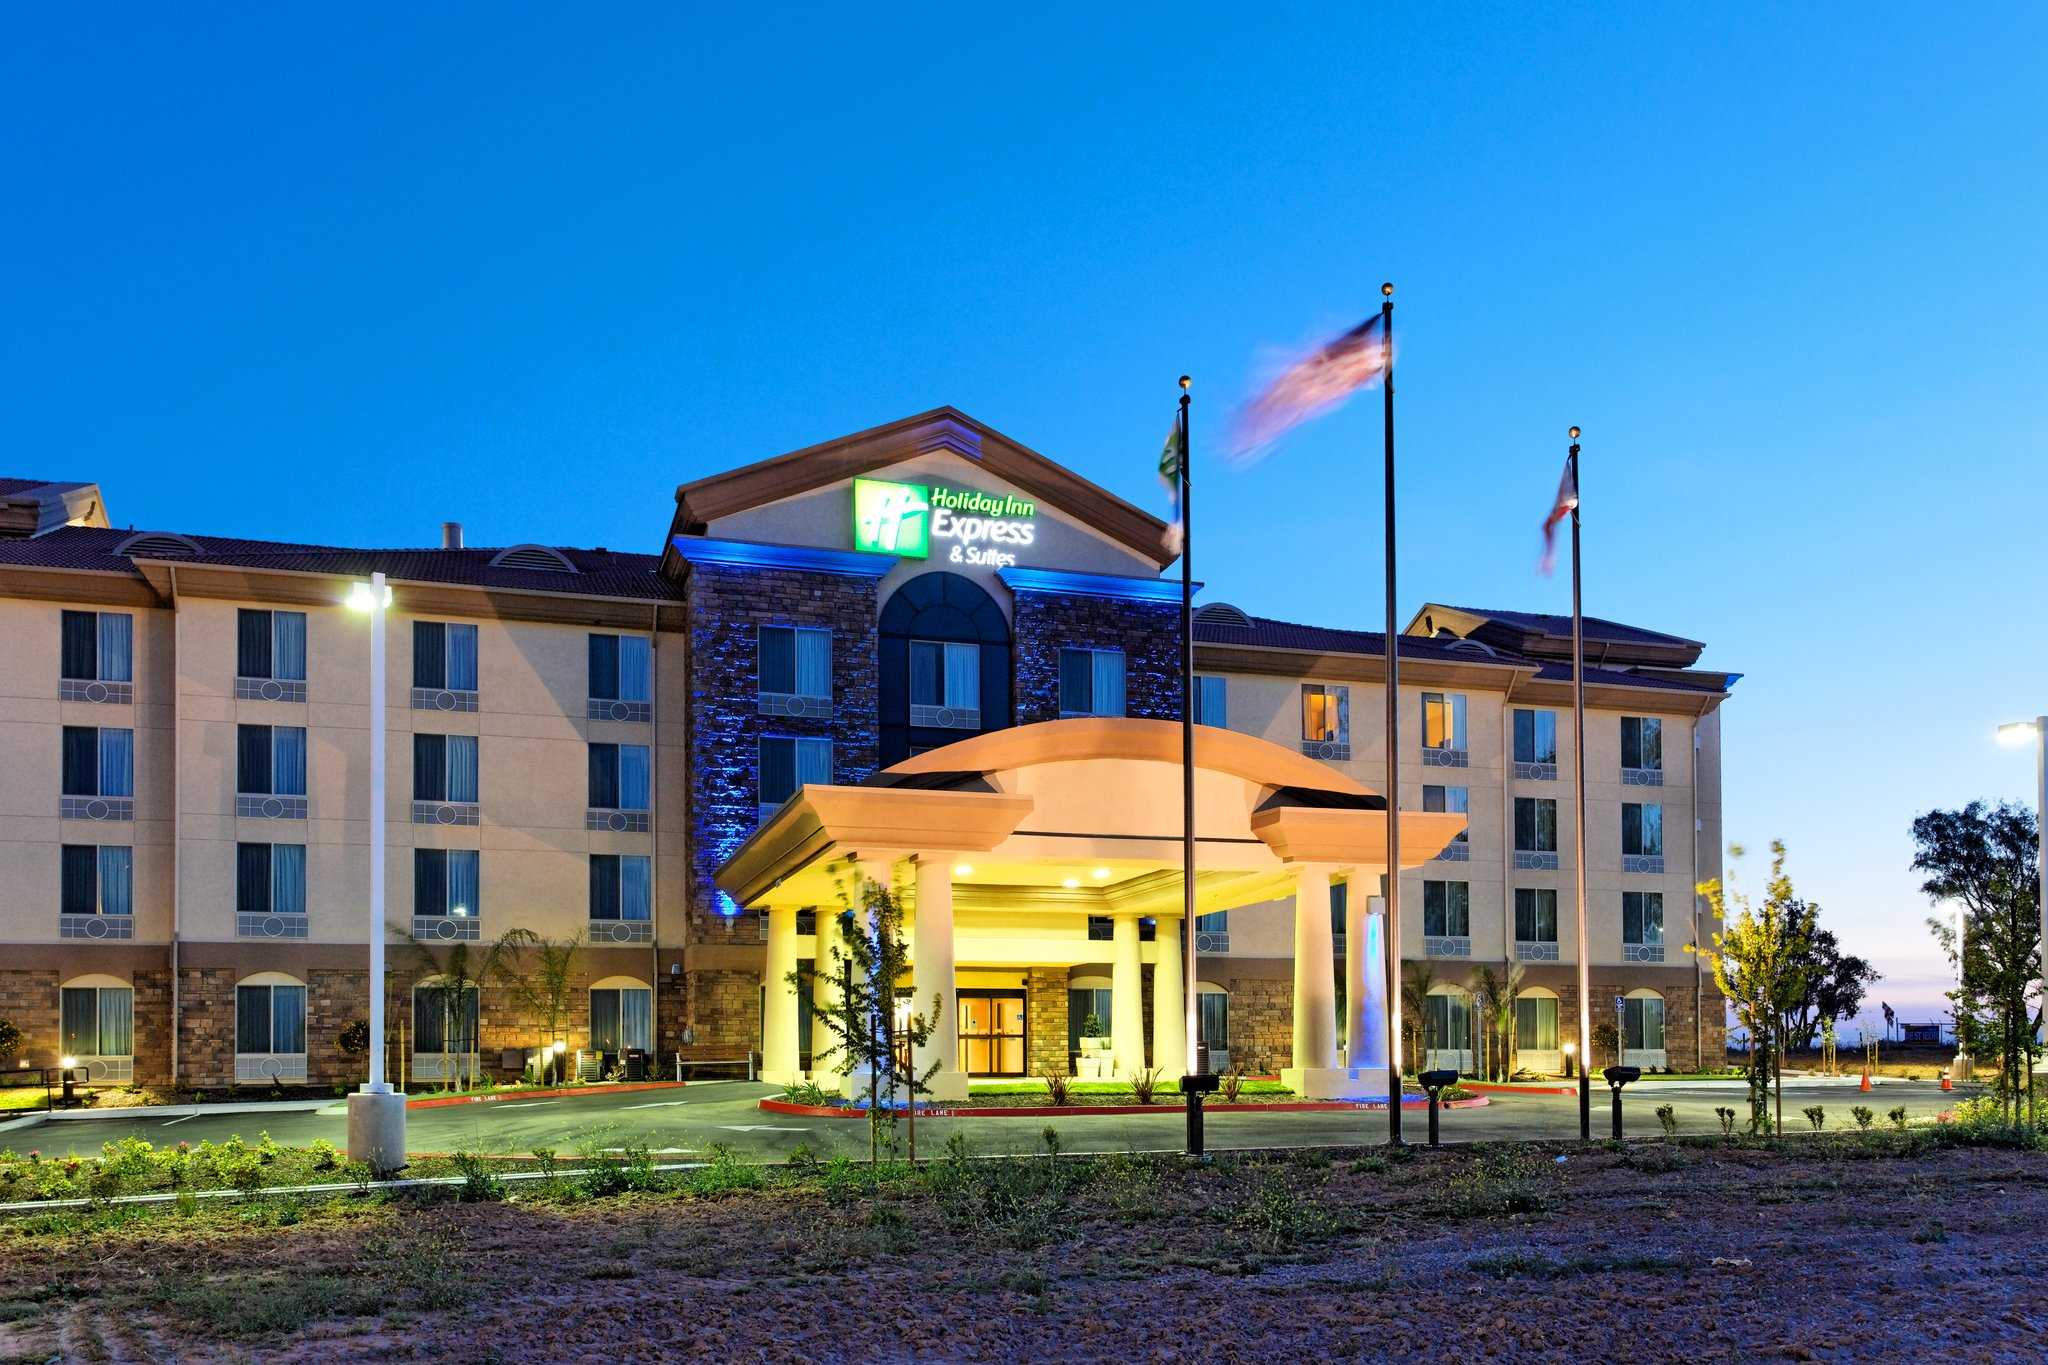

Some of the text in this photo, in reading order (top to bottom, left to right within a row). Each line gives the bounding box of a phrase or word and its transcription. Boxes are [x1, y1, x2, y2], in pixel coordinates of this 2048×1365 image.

[931, 487, 1035, 517] Holiday Inn
[931, 508, 1036, 546] Express
[949, 545, 1016, 566] & Suites
